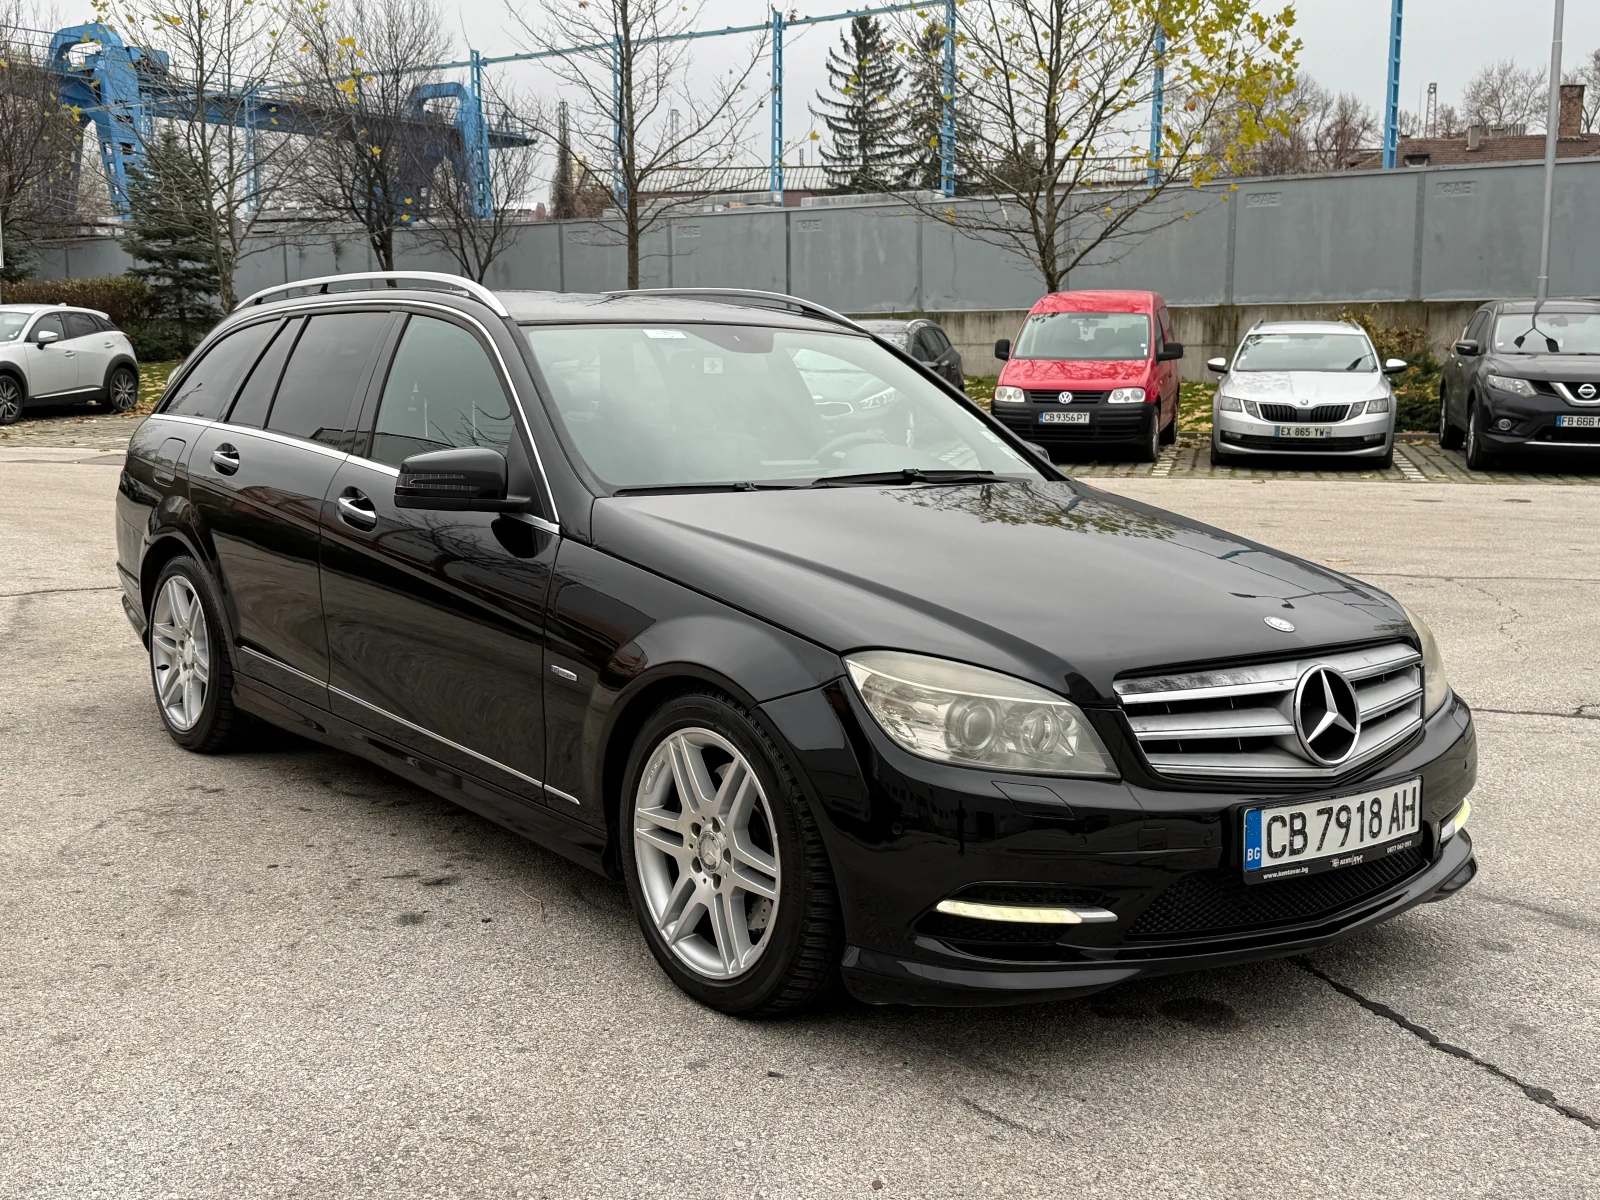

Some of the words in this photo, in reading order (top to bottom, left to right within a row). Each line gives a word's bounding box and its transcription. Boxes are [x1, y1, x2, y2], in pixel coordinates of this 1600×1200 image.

[1044, 413, 1055, 422] CB
[1056, 413, 1076, 422] 9356
[1076, 413, 1088, 422] PT
[1266, 812, 1308, 859] CB
[1315, 797, 1382, 852] 7918
[1387, 786, 1417, 835] AH
[1247, 847, 1261, 861] BG
